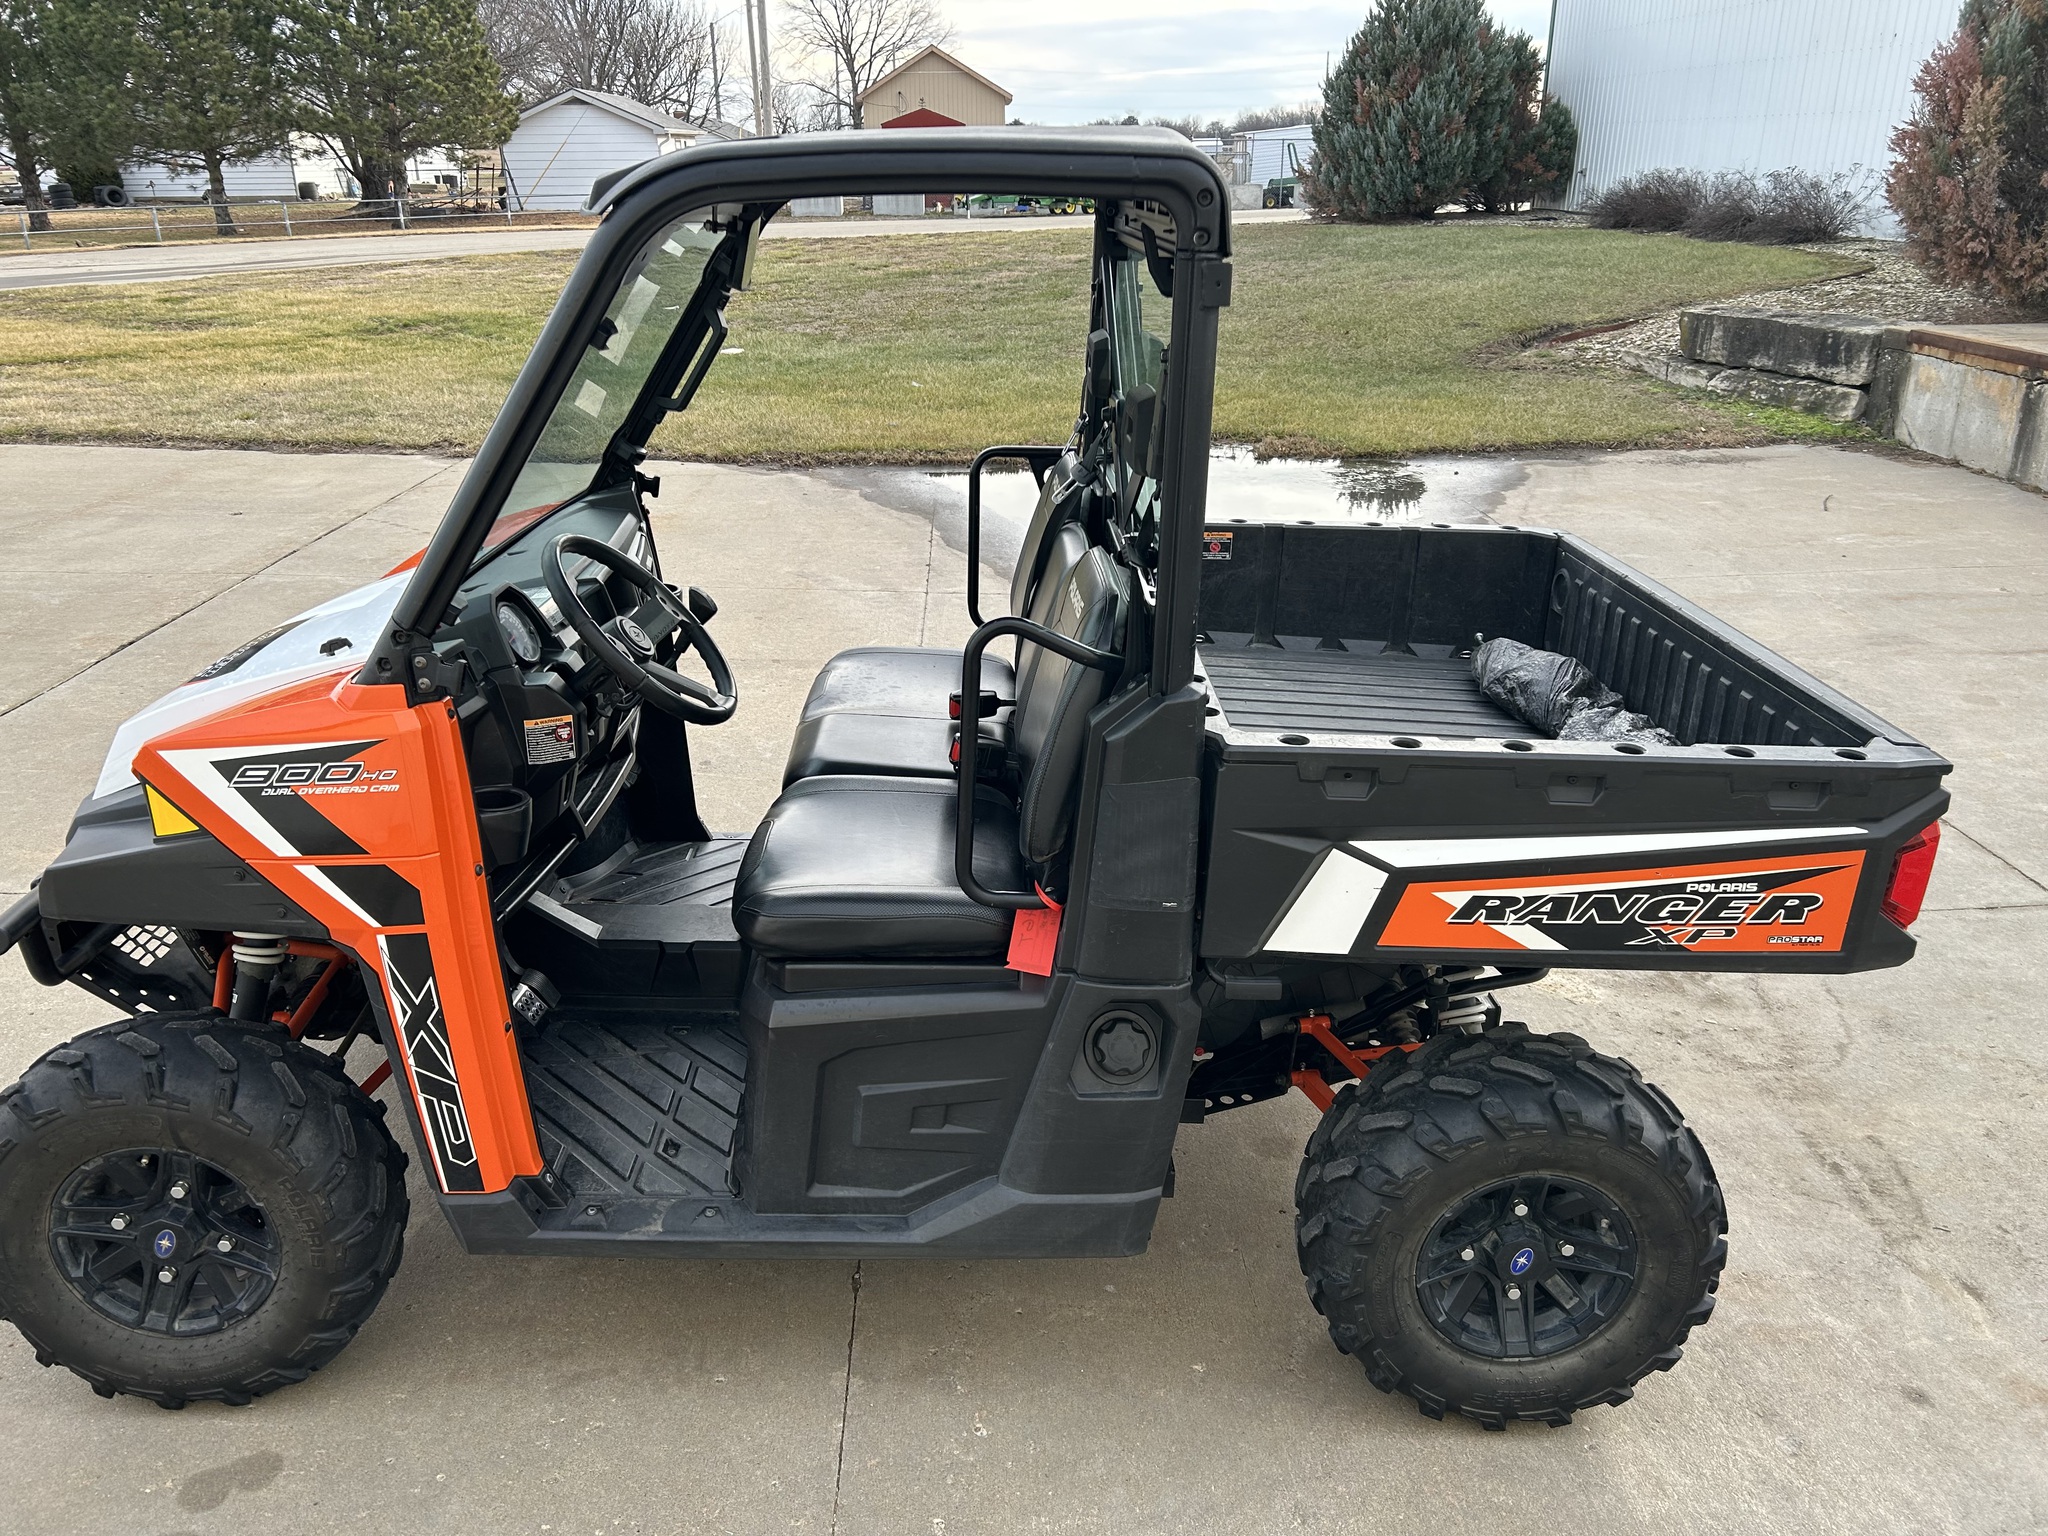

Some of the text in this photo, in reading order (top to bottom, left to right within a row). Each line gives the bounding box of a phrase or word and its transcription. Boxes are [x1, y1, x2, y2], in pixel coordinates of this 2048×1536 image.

[228, 761, 398, 788] 900 HO
[261, 784, 400, 796] DUAL OVERHEAD CAM
[1686, 882, 1759, 893] POLARIS
[1445, 893, 1824, 926] RANGER
[1624, 926, 1738, 945] XP
[1767, 935, 1824, 944] PROSTAR
[380, 945, 477, 1166] XP
